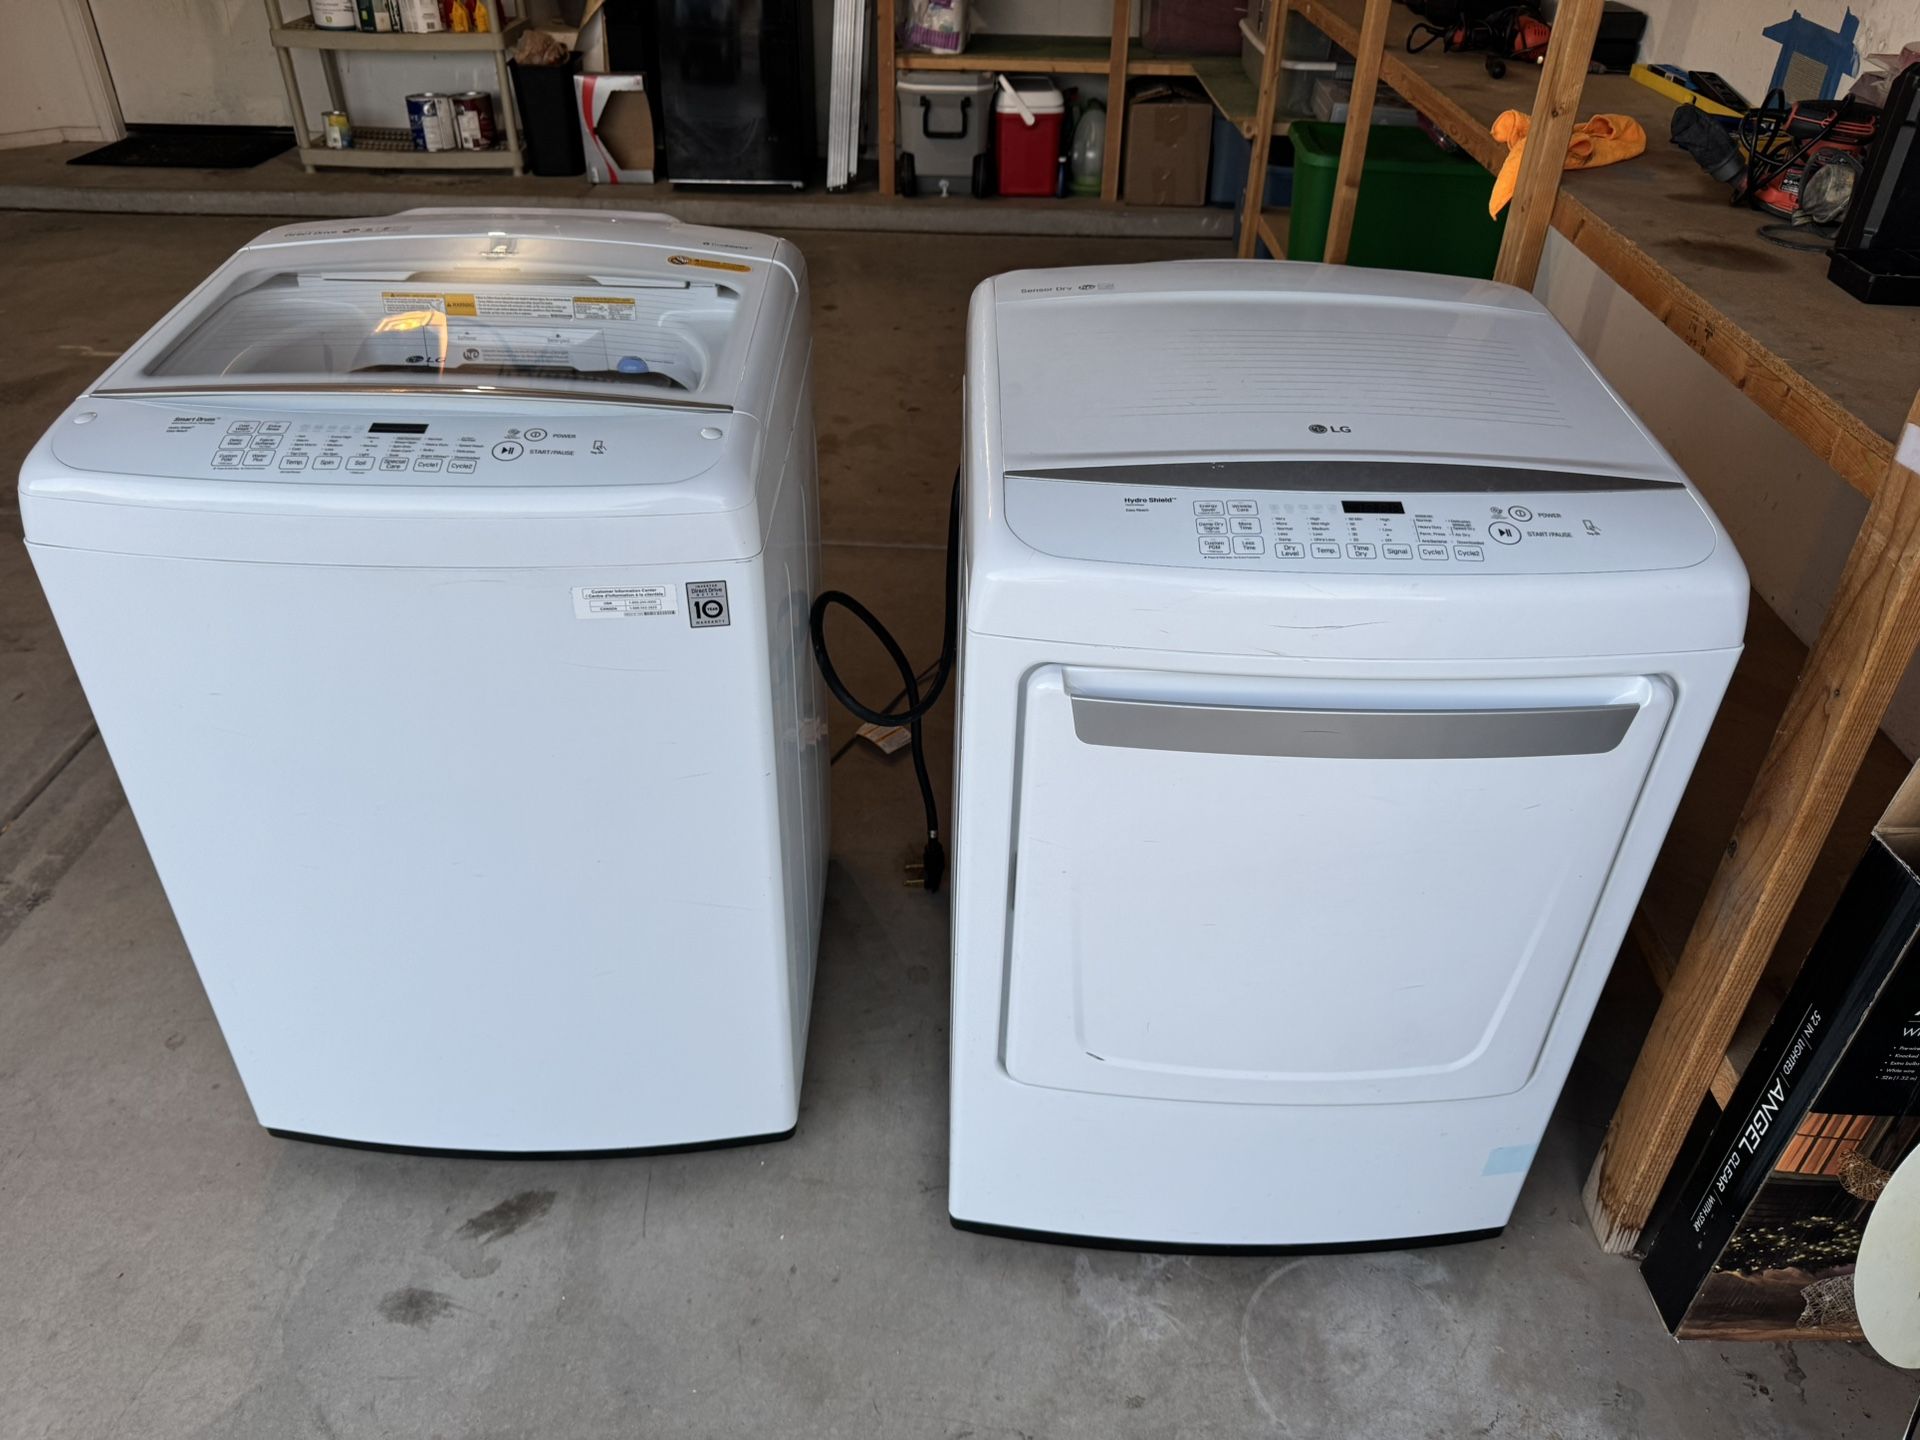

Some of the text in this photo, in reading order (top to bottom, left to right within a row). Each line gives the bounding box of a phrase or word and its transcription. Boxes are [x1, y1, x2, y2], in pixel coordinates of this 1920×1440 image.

[694, 600, 724, 619] 10
[1694, 1010, 1822, 1232] 52 IN LIGHTED ANGEL CLEAR WITH STAR
